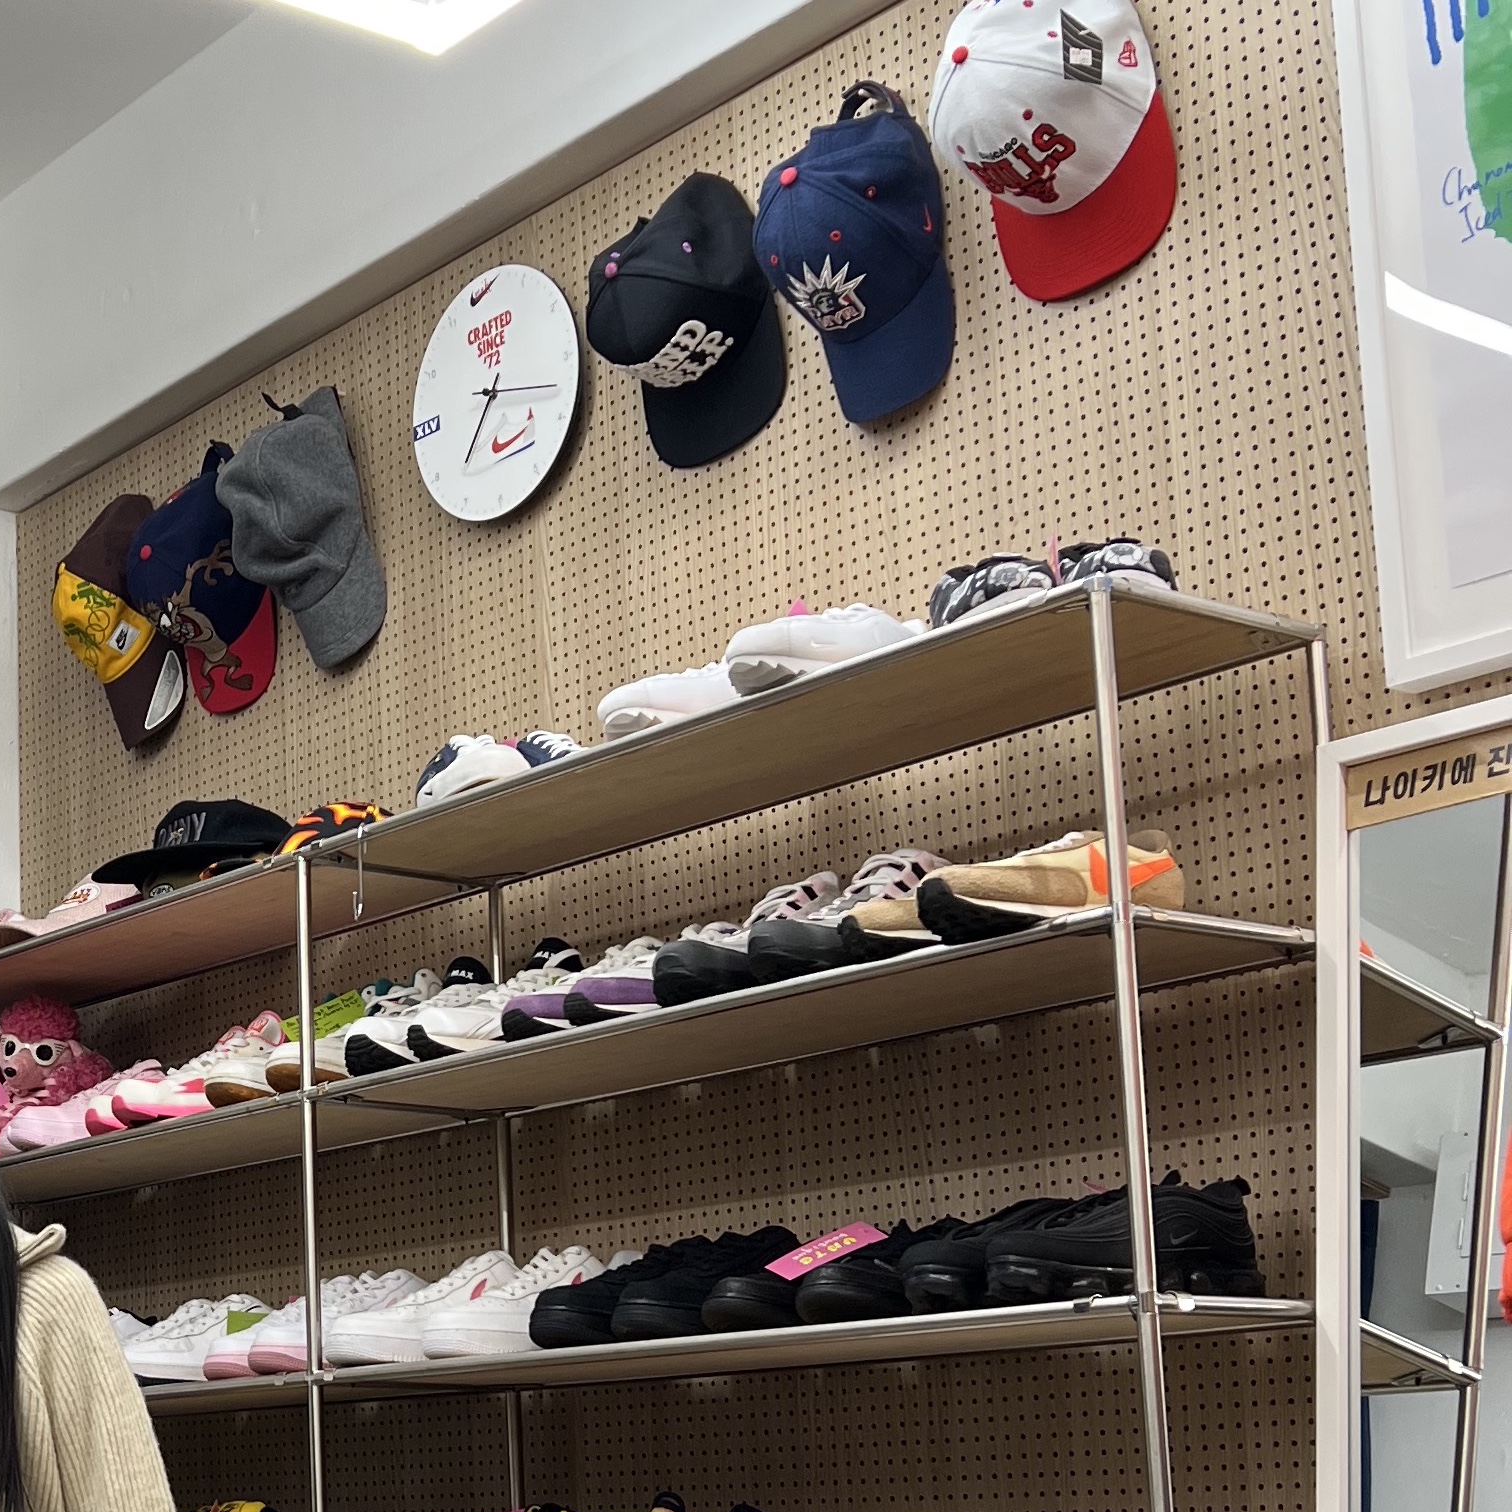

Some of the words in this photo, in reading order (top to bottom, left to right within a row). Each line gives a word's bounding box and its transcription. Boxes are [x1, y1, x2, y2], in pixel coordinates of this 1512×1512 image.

[467, 310, 512, 346] CRAFTED
[477, 329, 506, 358] SINCE
[483, 350, 501, 370] '72
[414, 416, 439, 440] XLV
[1364, 753, 1476, 807] 나이키에
[450, 969, 475, 980] MAX
